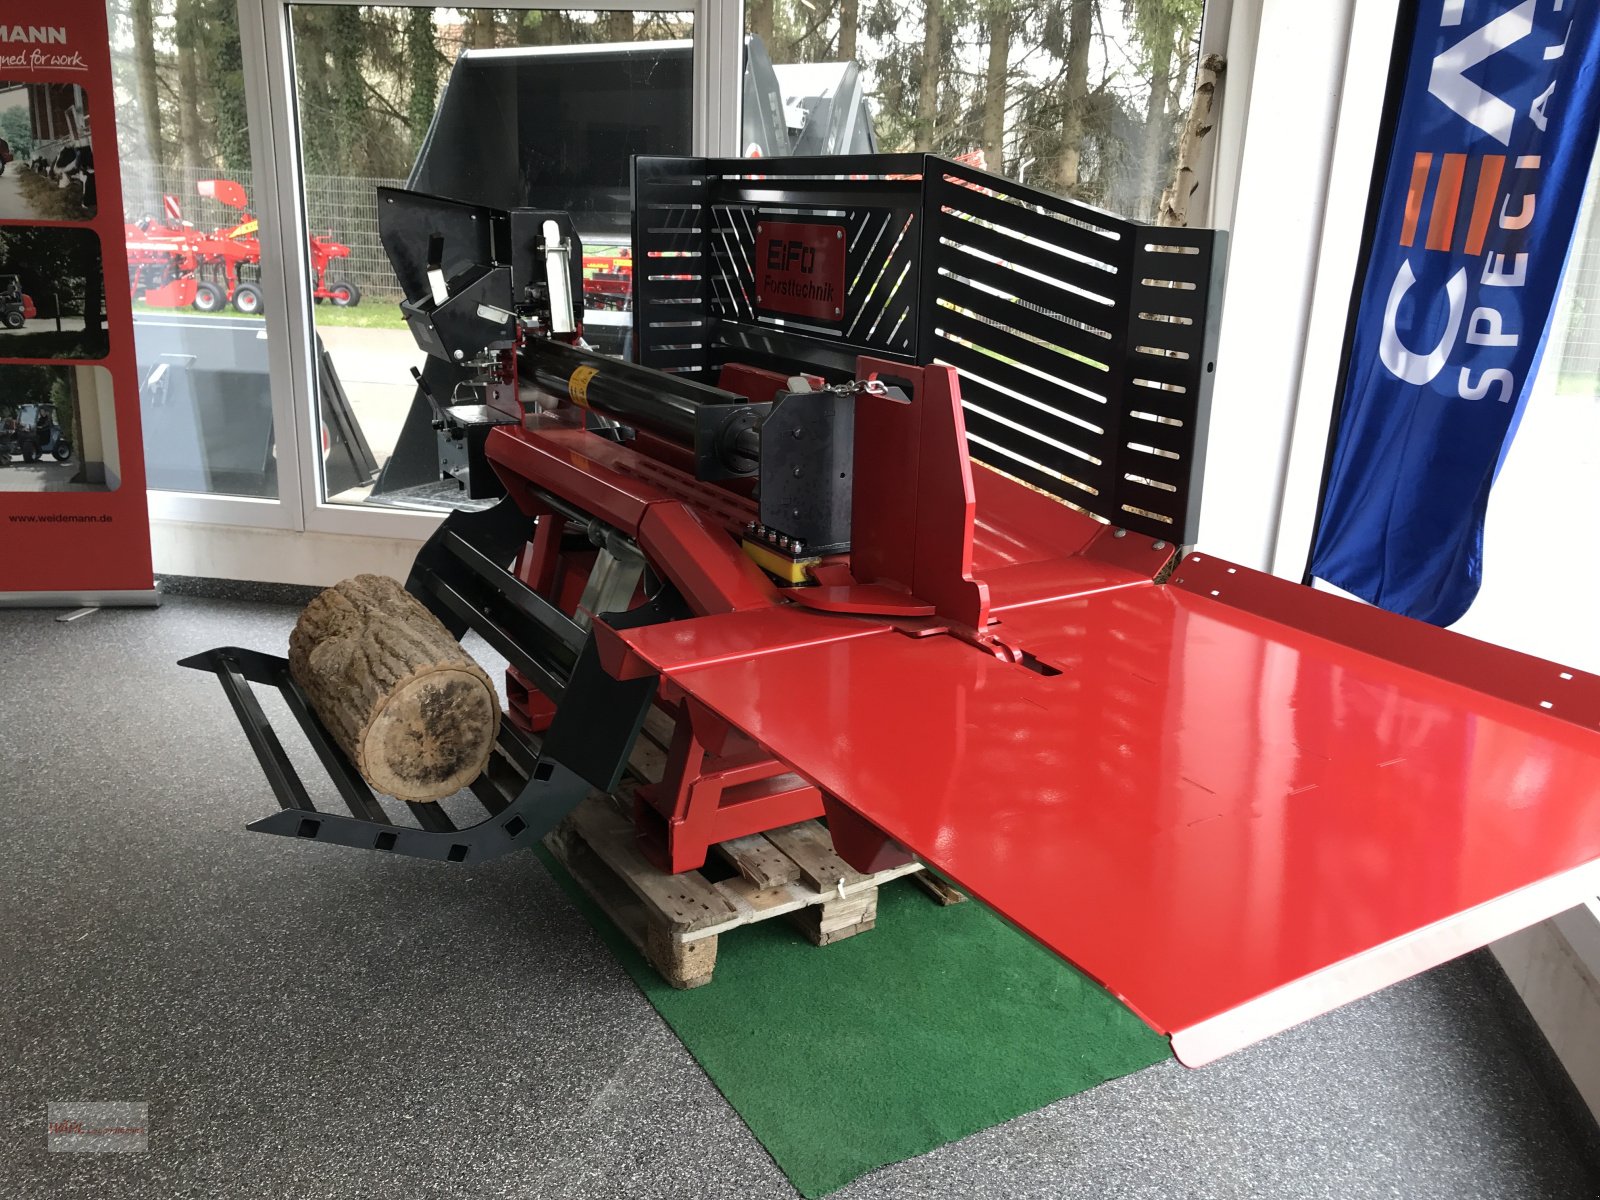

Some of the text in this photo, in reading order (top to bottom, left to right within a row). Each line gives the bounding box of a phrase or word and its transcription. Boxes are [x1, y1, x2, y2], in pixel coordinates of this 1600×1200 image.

[30, 48, 51, 72] for
[50, 50, 88, 68] work
[763, 274, 834, 302] Forsttechnik
[8, 513, 113, 523] www.weidemann.de
